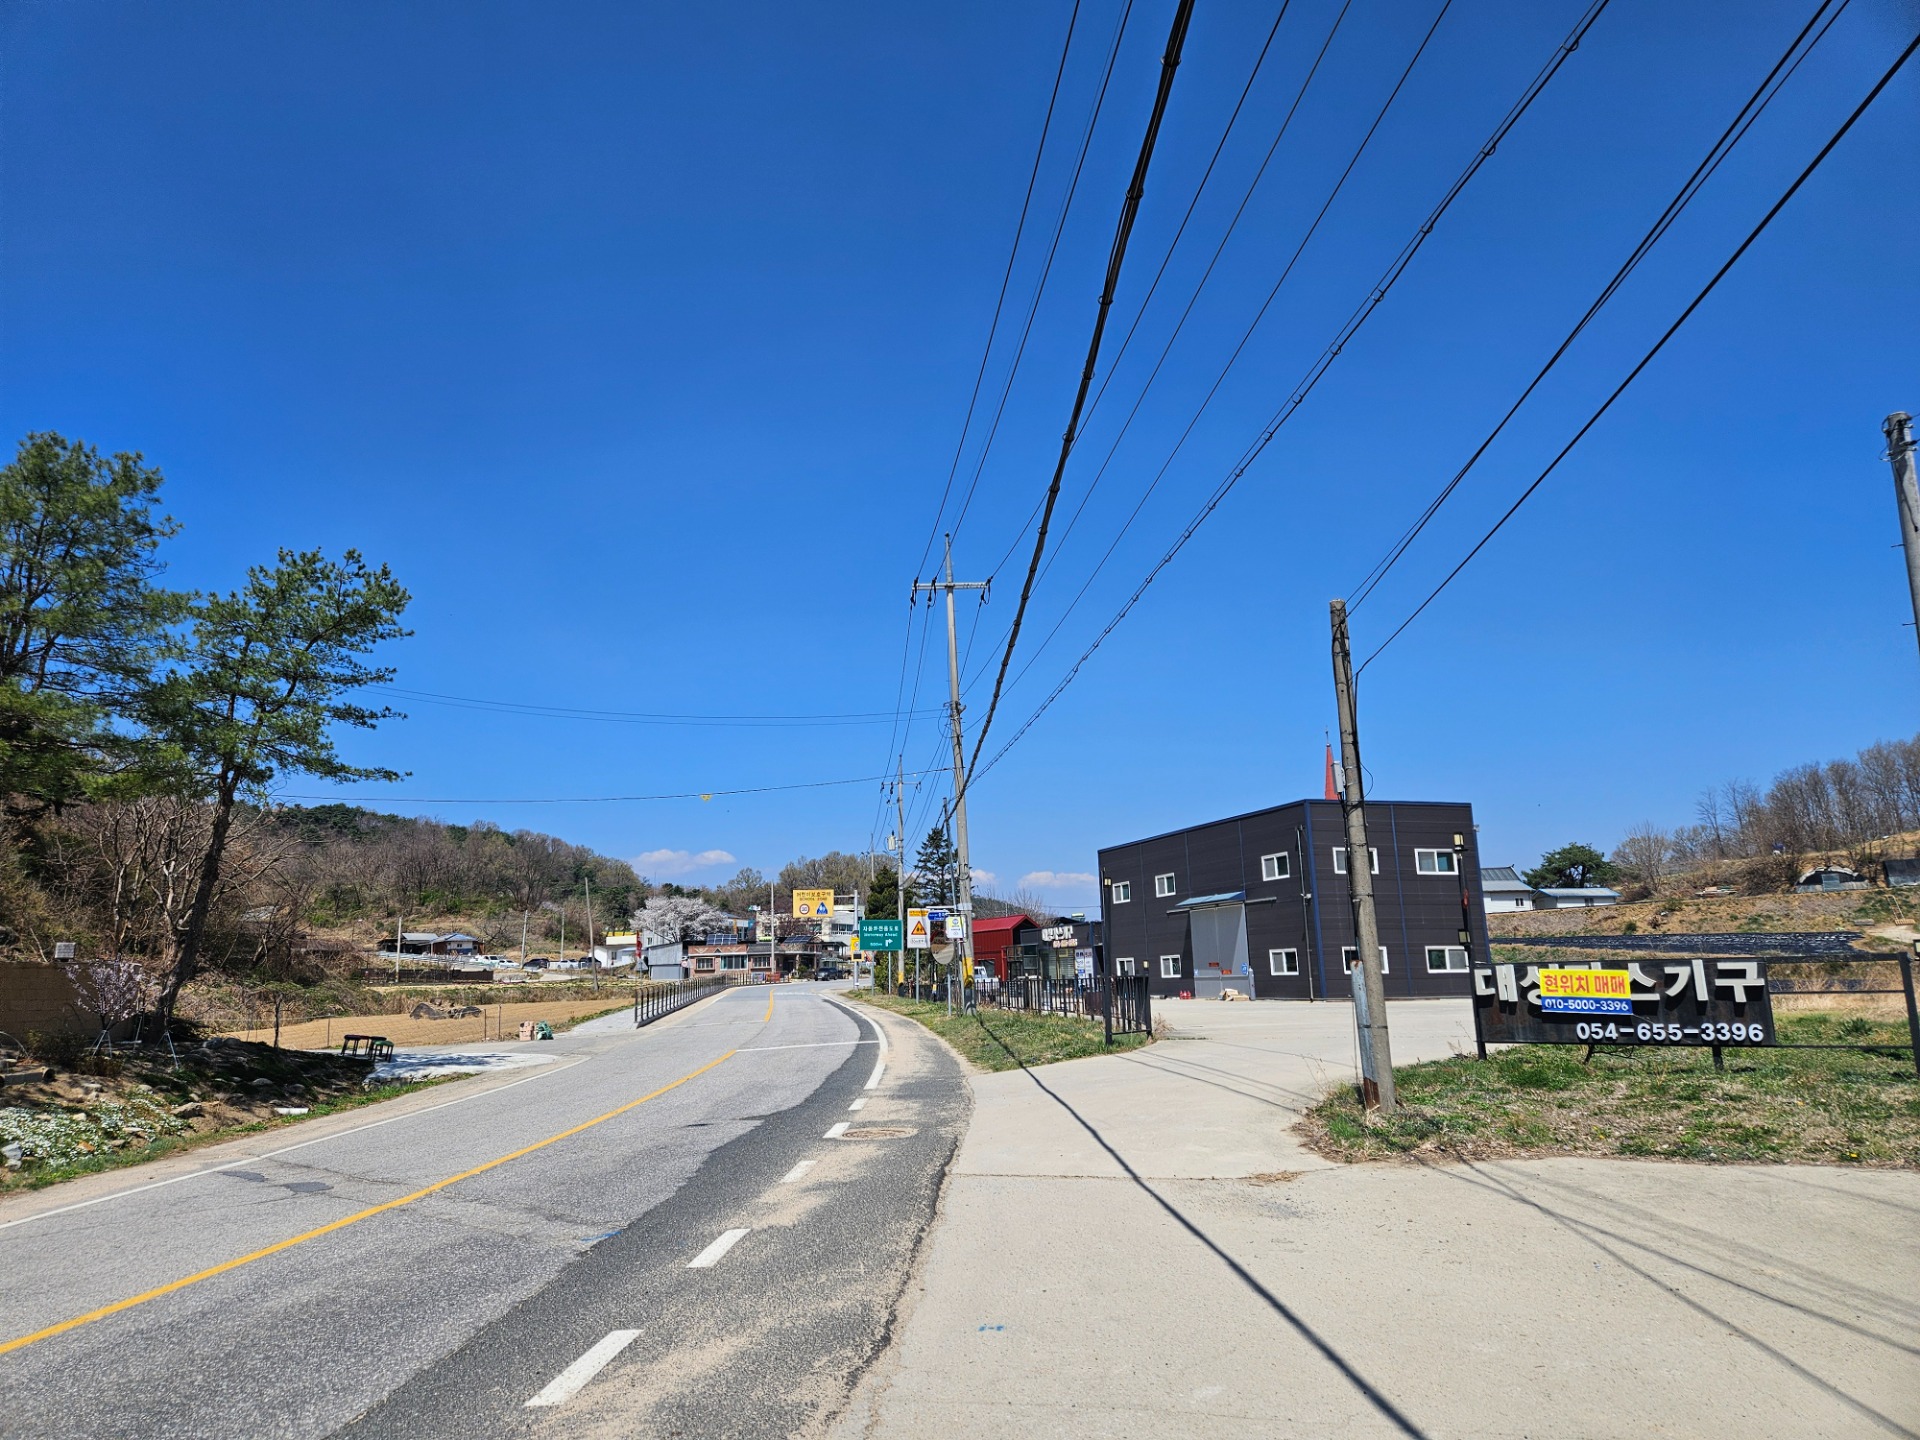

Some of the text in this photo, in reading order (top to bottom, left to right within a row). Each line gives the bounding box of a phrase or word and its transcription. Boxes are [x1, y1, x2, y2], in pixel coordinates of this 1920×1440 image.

[1474, 959, 1765, 1006] 대스기구
[1544, 974, 1626, 994] 현위치 매매
[1545, 999, 1629, 1011] 010-5000-3396
[1576, 1022, 1764, 1042] 054-655-3396
